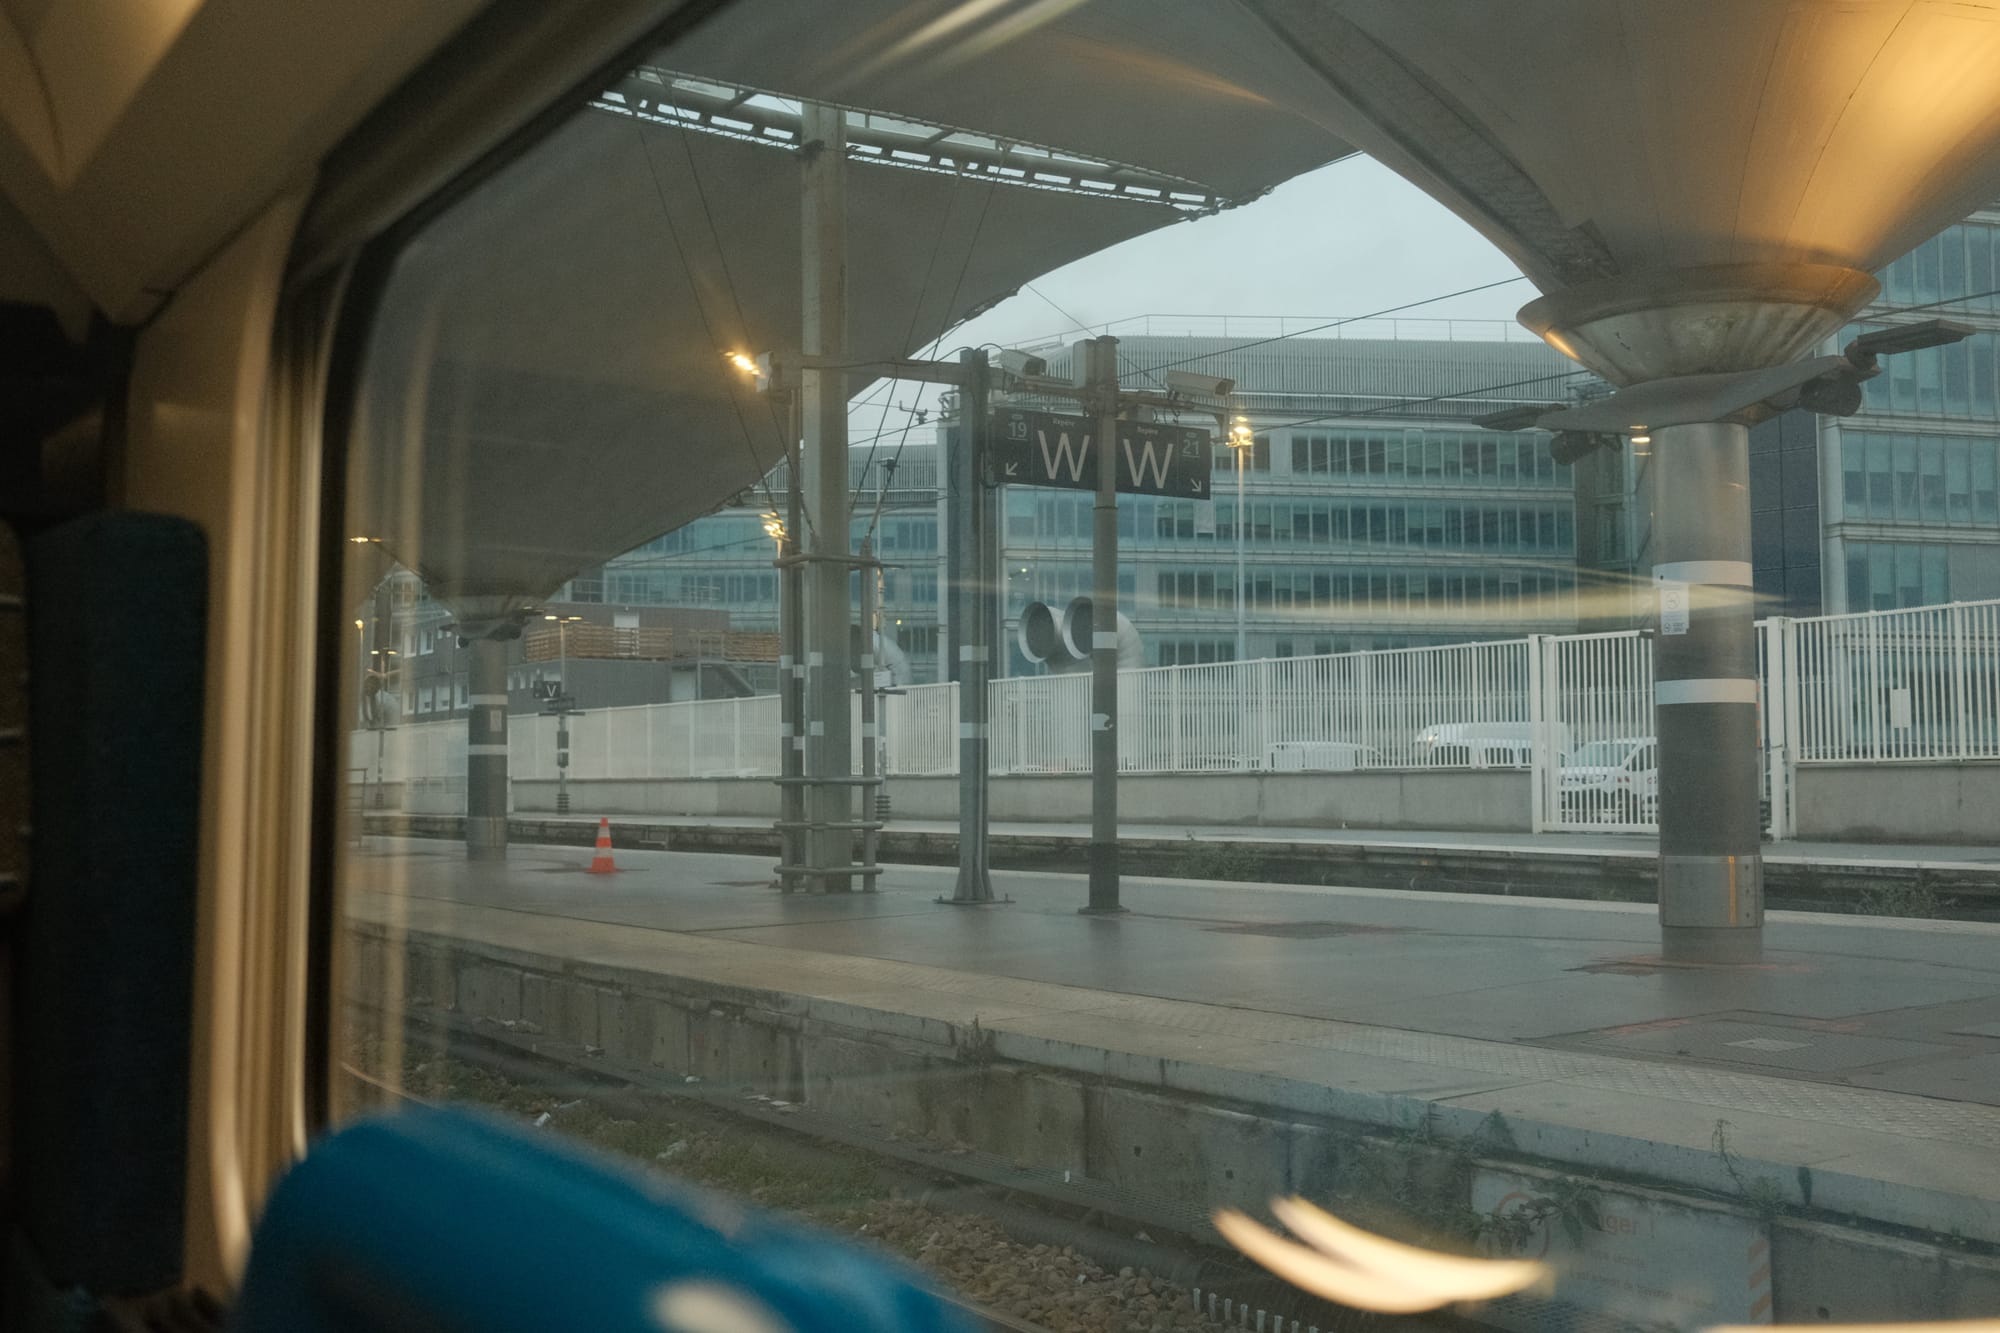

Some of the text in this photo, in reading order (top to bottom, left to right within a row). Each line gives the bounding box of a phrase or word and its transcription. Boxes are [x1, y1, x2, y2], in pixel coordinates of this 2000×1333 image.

[1008, 422, 1027, 438] 19
[1182, 439, 1199, 455] 21
[1037, 430, 1090, 482] W
[1123, 438, 1174, 488] W
[546, 685, 557, 697] V
